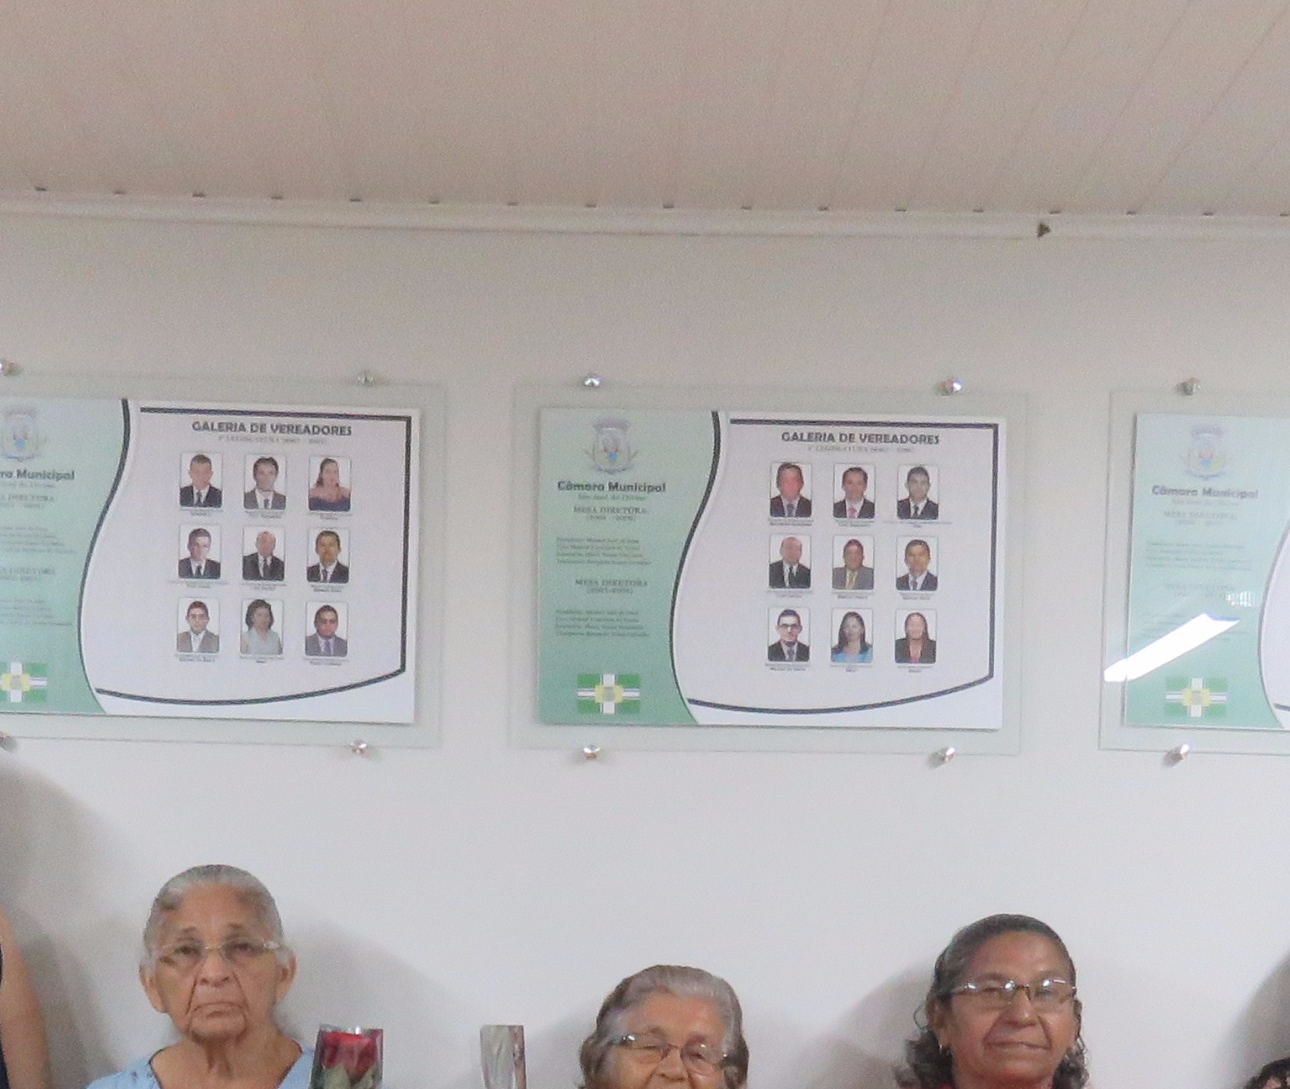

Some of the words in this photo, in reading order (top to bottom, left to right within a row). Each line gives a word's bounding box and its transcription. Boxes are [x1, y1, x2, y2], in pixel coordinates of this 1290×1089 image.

[191, 421, 247, 433] GALERIA
[250, 422, 267, 434] DE
[270, 423, 352, 436] VEREADORES
[781, 432, 836, 443] GALERIA
[838, 432, 855, 444] DE
[859, 433, 940, 445] VEREADORES
[16, 468, 75, 481] Municipal
[557, 480, 604, 491] Câmara
[608, 482, 666, 493] Municipal
[1151, 485, 1198, 496] Câmara
[1202, 487, 1259, 499] Municipal
